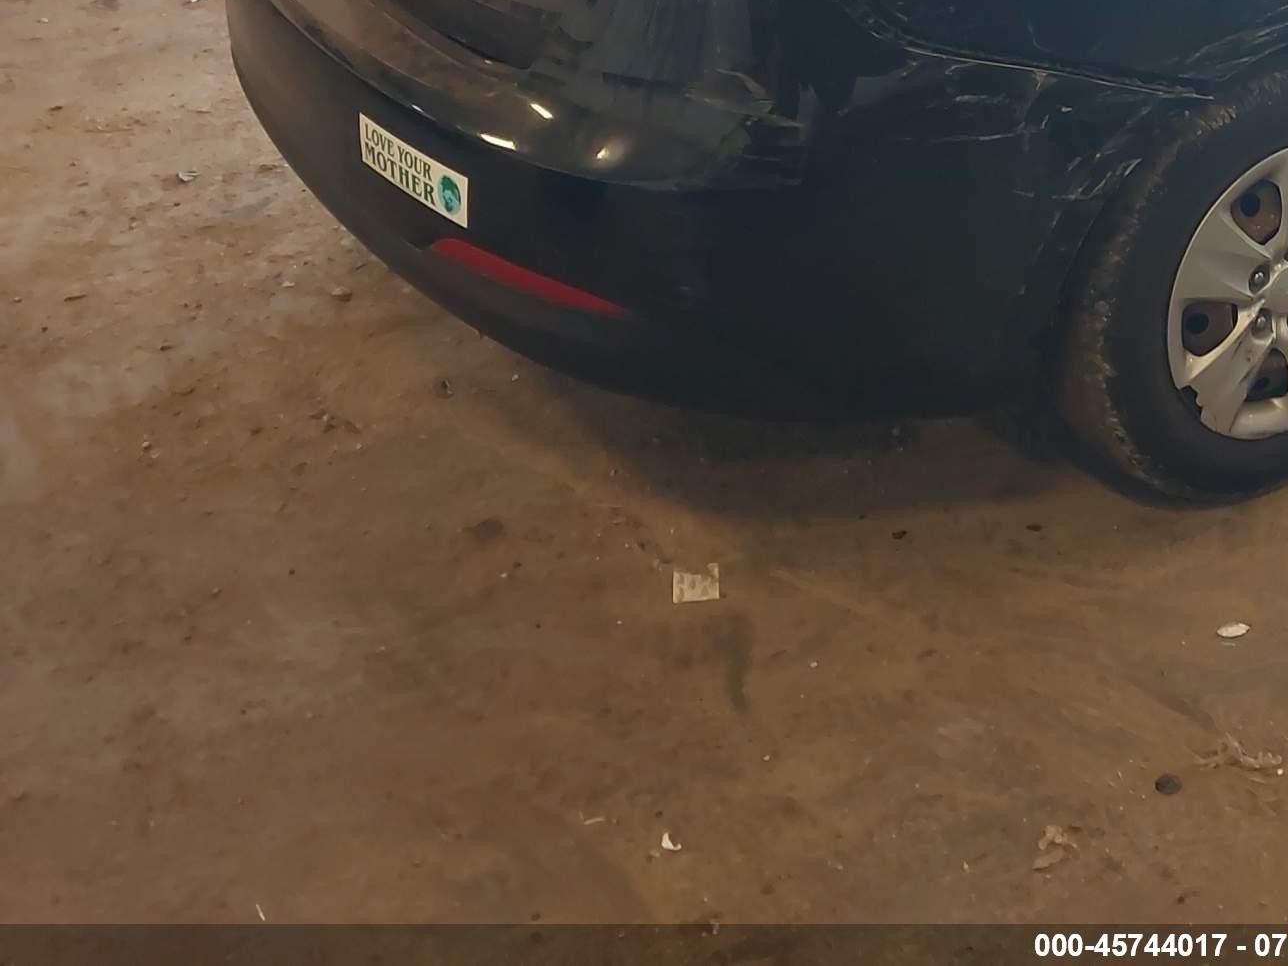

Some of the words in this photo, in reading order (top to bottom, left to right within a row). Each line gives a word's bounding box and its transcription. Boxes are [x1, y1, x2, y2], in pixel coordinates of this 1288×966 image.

[364, 123, 396, 158] LOVE
[397, 145, 433, 183] YOUR
[364, 141, 437, 207] MOTHER
